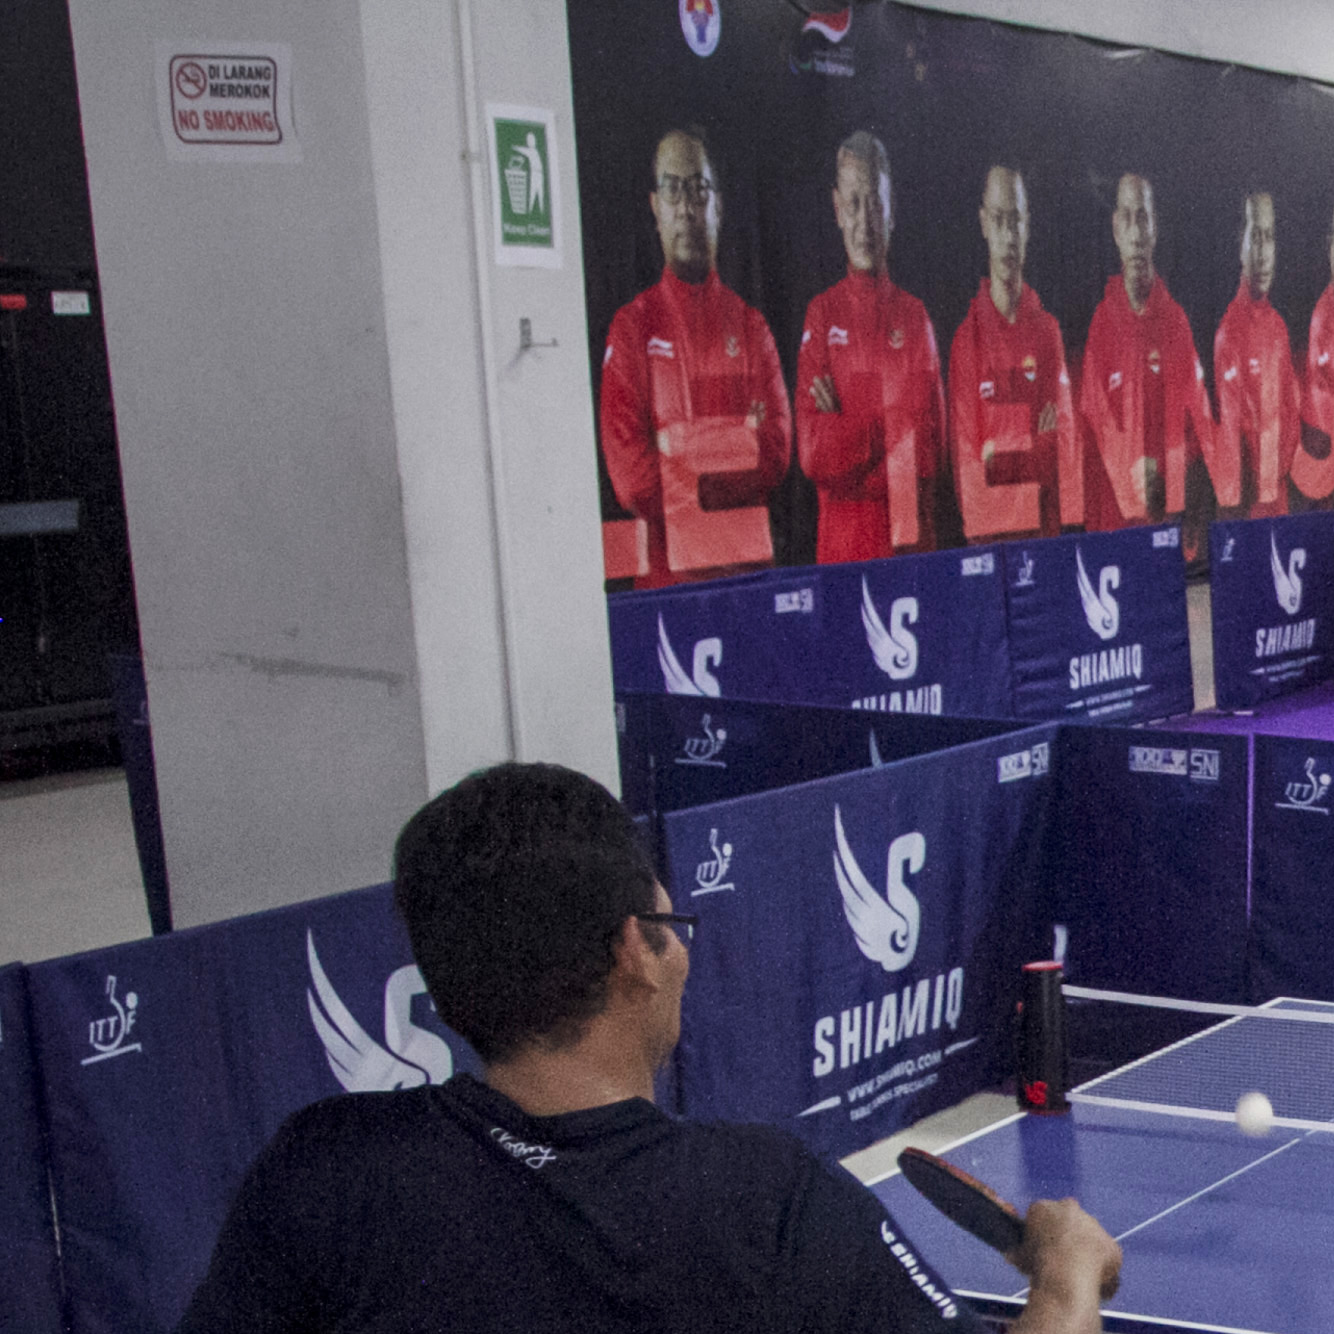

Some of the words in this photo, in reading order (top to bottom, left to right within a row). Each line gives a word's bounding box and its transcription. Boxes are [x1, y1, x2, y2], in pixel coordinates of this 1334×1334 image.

[208, 64, 220, 79] DI
[224, 64, 272, 80] LARANG
[209, 83, 271, 99] MEROKOK
[178, 110, 200, 130] NO
[203, 110, 275, 132] SMOKING
[1069, 643, 1143, 691] SHIAMIQ
[89, 1010, 137, 1045] ITTF
[813, 966, 964, 1078] SHIAMIQ
